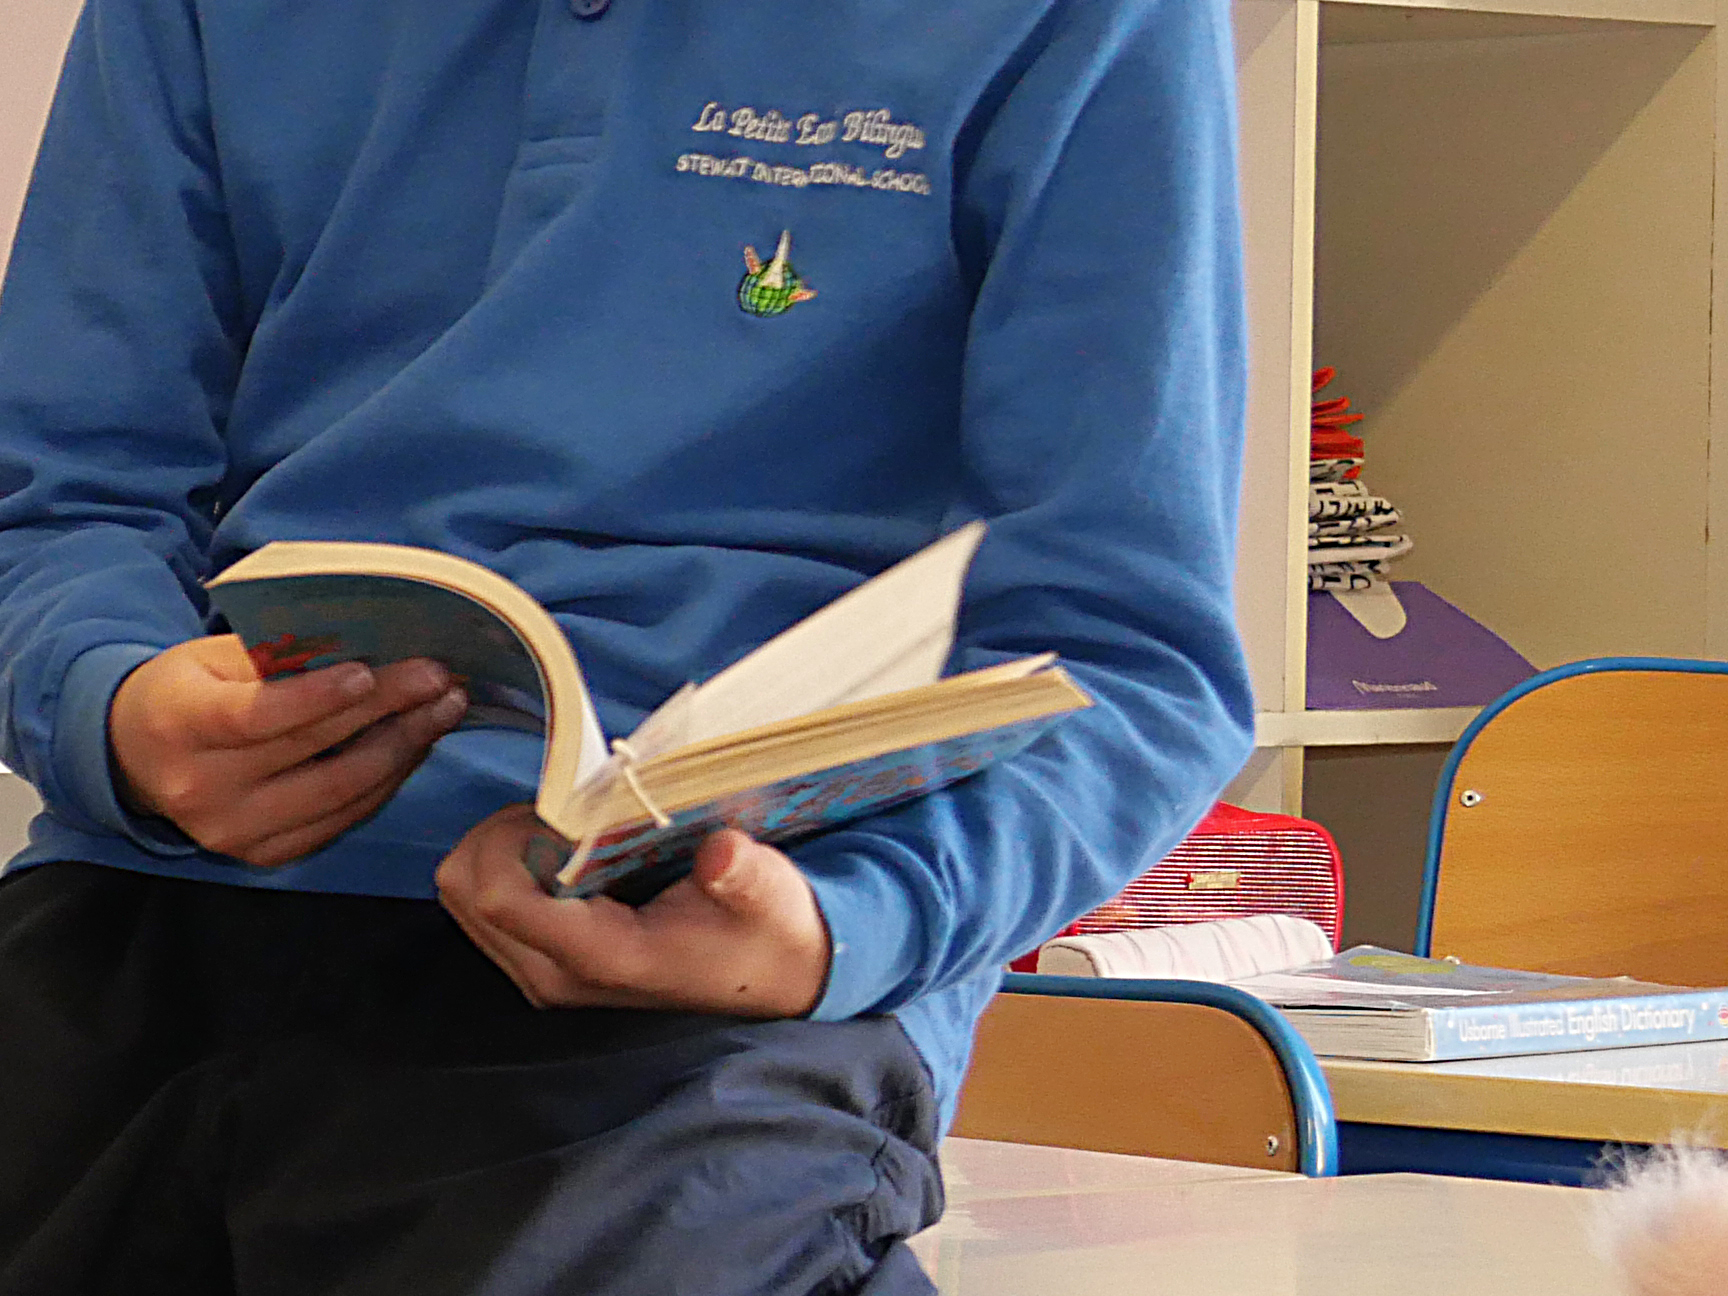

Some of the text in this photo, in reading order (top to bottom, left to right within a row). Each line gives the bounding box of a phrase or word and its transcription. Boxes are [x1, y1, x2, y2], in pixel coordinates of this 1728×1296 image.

[1459, 1022, 1505, 1042] Usborne
[1569, 1007, 1618, 1041] English
[1622, 1002, 1696, 1034] Dictionary
